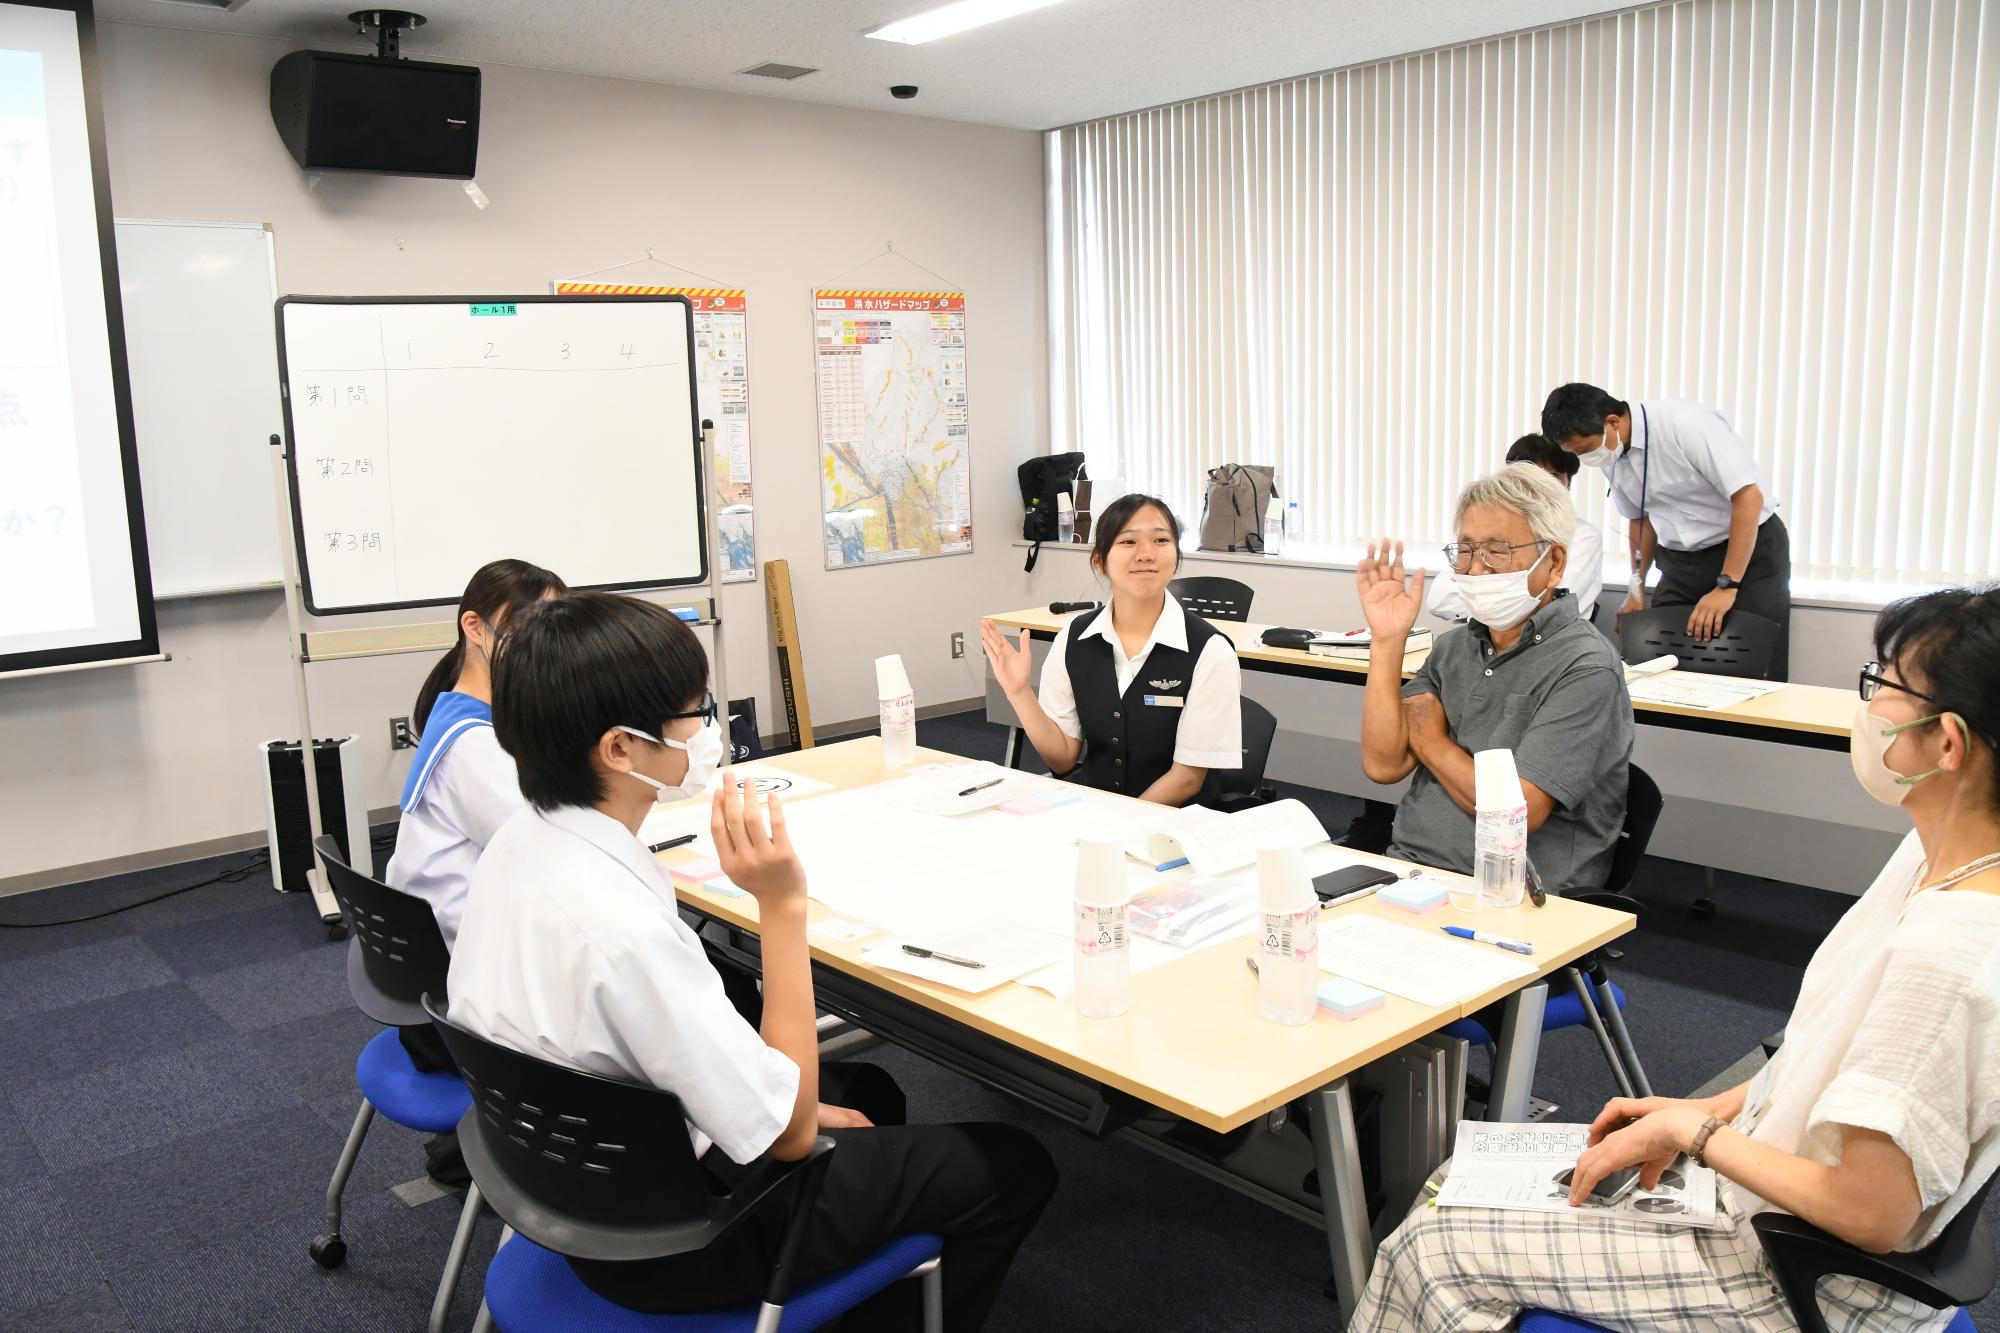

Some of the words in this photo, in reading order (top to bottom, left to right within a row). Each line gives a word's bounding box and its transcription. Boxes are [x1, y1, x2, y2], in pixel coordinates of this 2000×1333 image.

[471, 305, 516, 315] ホール1用
[854, 298, 931, 311] 洪水ハザードマップ
[484, 342, 499, 359] 2
[562, 343, 571, 360] 3
[620, 344, 637, 361] 4
[304, 384, 369, 408] 第1問
[316, 456, 374, 480] 第2問
[325, 531, 382, 553] 第3問
[784, 678, 799, 743] MOZOUSHI
